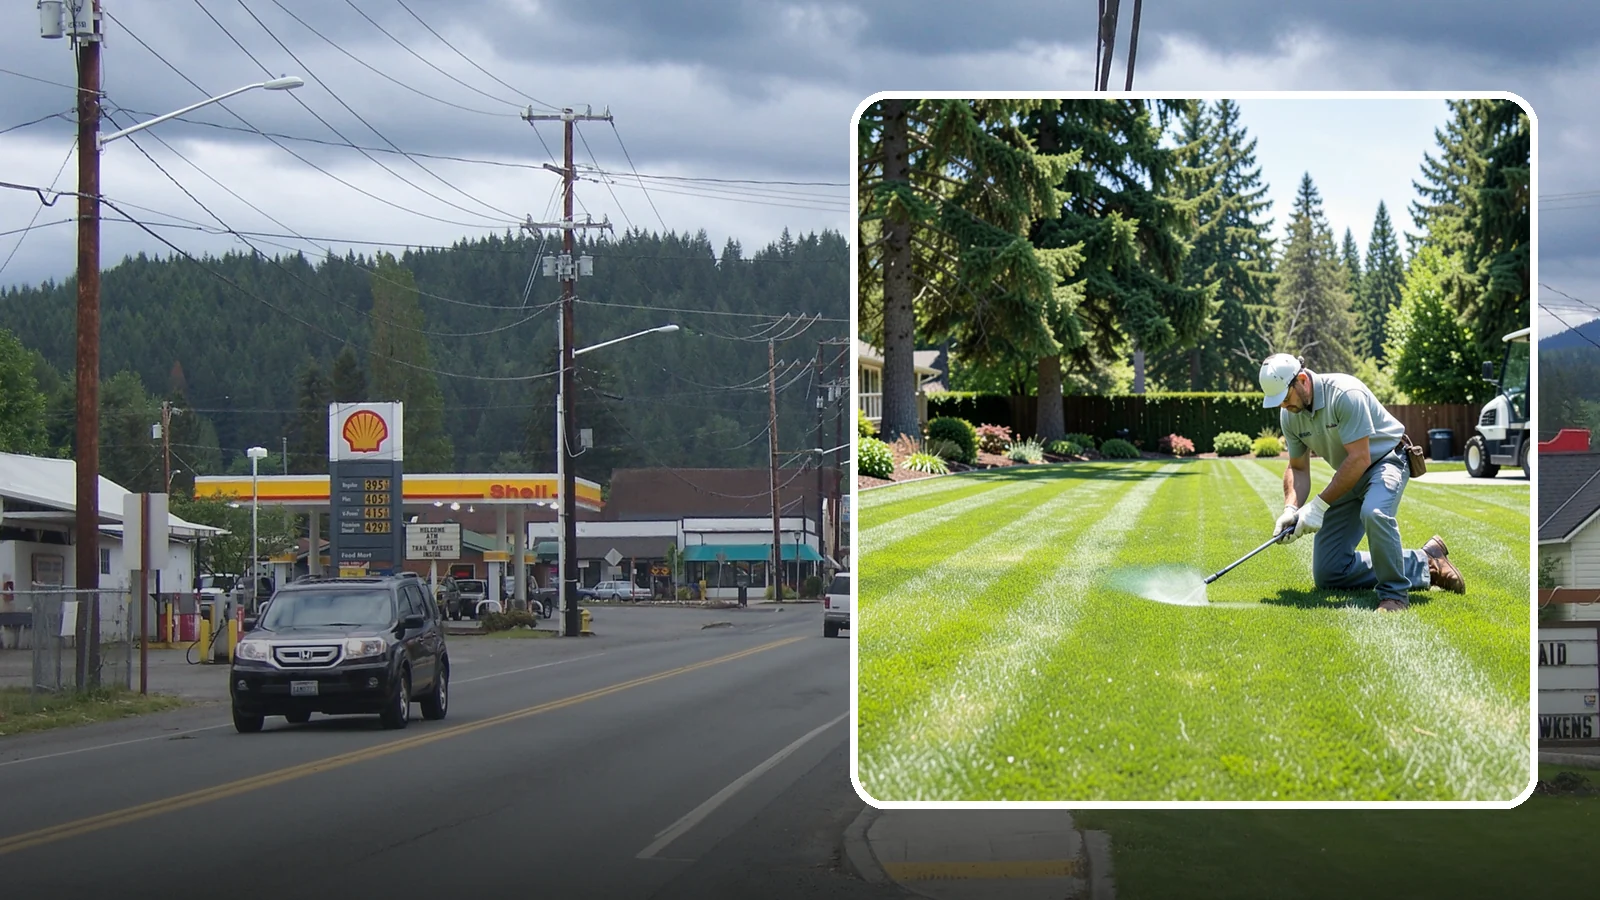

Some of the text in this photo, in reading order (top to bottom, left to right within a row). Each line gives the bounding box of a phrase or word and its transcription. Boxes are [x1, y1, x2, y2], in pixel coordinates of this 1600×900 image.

[366, 480, 383, 490] 395
[490, 484, 547, 499] Shell
[366, 494, 383, 504] 405
[366, 508, 383, 518] 415
[366, 522, 383, 532] 429
